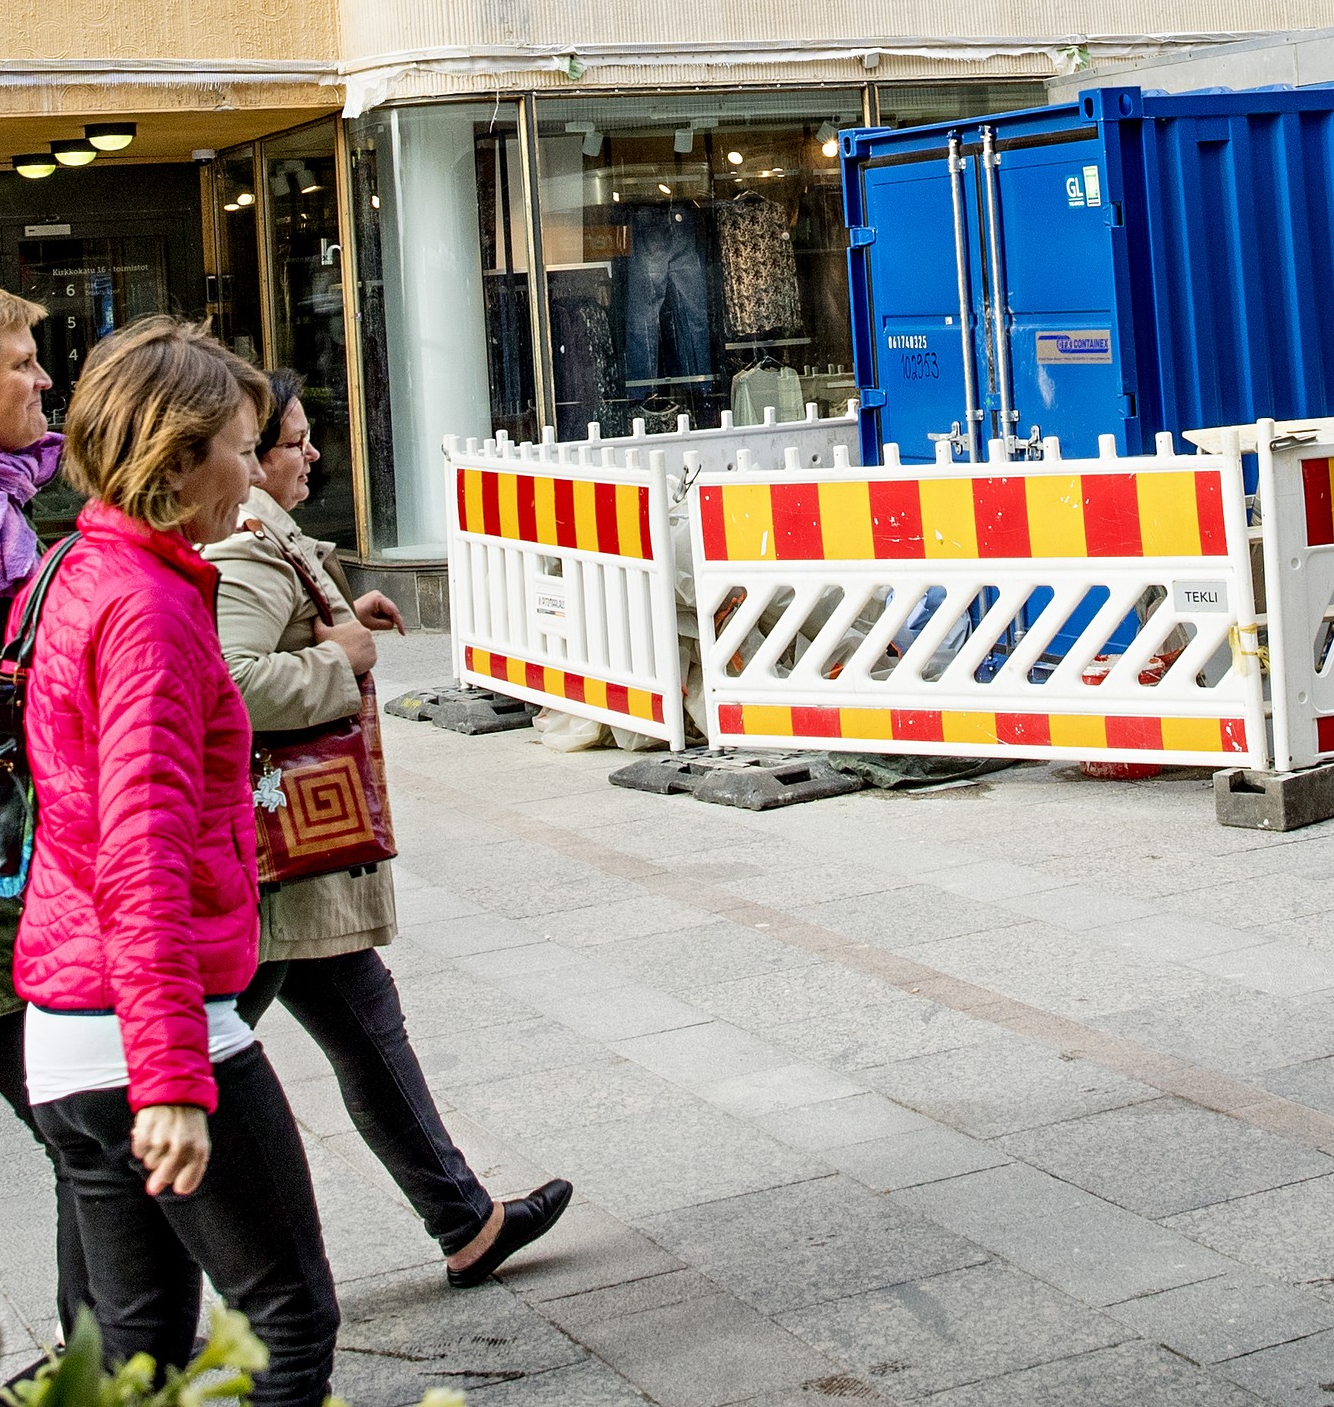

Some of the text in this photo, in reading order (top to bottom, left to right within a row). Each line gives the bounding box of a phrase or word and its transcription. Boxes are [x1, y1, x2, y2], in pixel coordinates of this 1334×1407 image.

[1066, 176, 1084, 198] GL
[52, 267, 96, 276] Kirkkokatu
[113, 264, 149, 273] toimistot
[66, 284, 76, 297] 6
[67, 316, 76, 329] 5
[1073, 338, 1108, 350] CONTAINEX
[69, 348, 78, 361] 4
[901, 352, 940, 381] 102953
[1184, 591, 1218, 603] TEKLI
